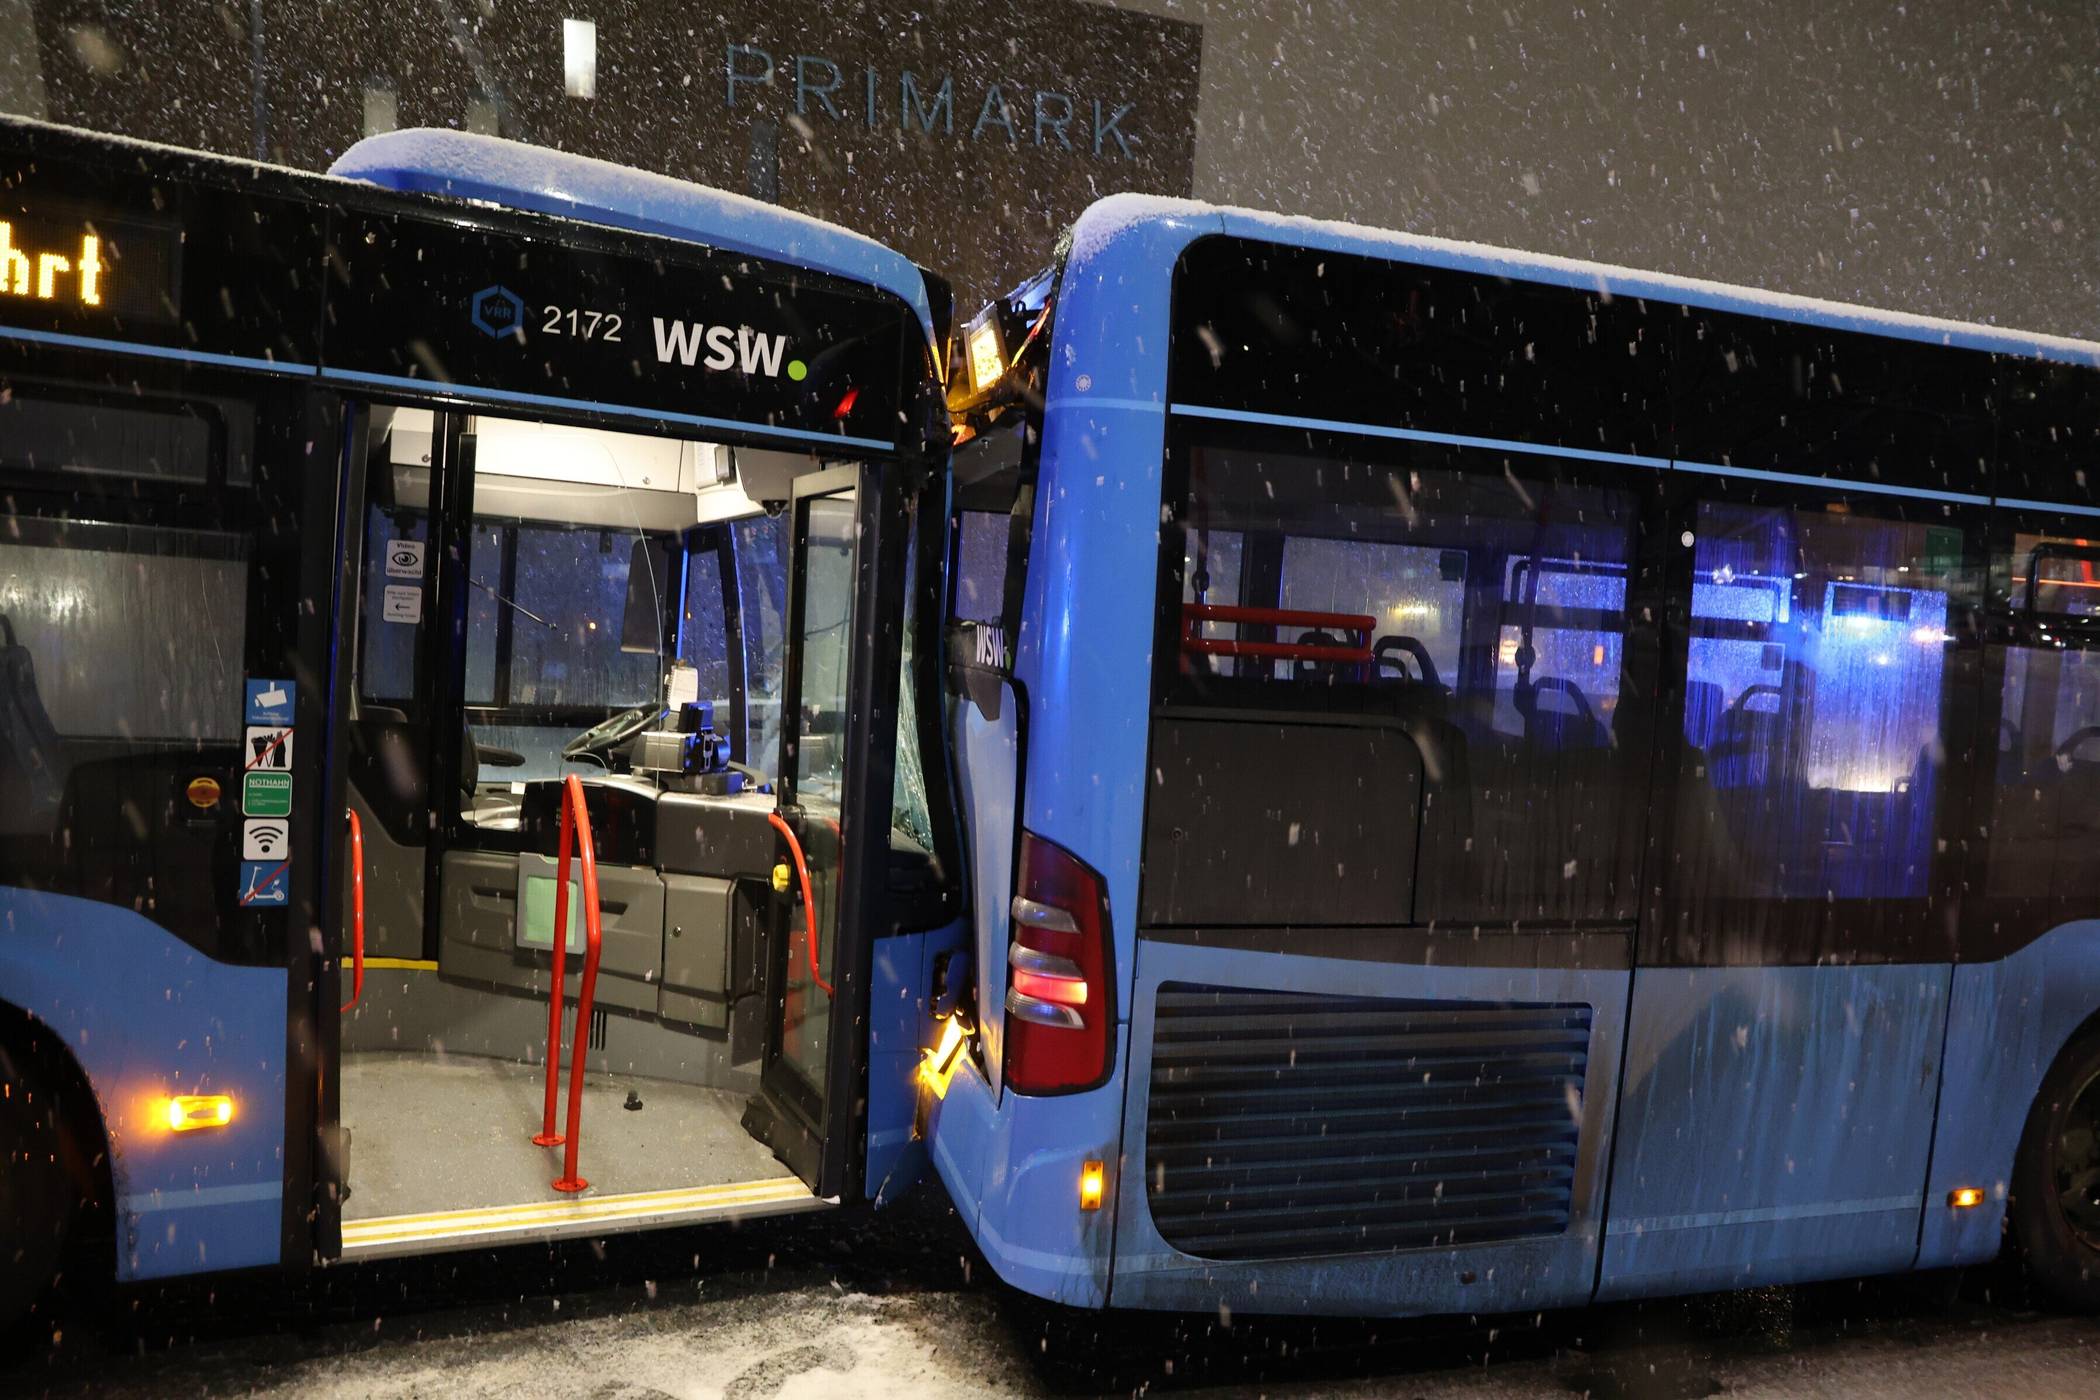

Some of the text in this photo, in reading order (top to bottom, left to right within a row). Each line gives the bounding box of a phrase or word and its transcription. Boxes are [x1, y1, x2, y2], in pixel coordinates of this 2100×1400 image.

[725, 43, 1136, 161] PRIMARK
[0, 221, 102, 305] hrt
[542, 305, 623, 343] 2172
[653, 317, 786, 377] WSW
[976, 624, 1003, 668] WSW
[249, 778, 290, 787] NOTHAHN
